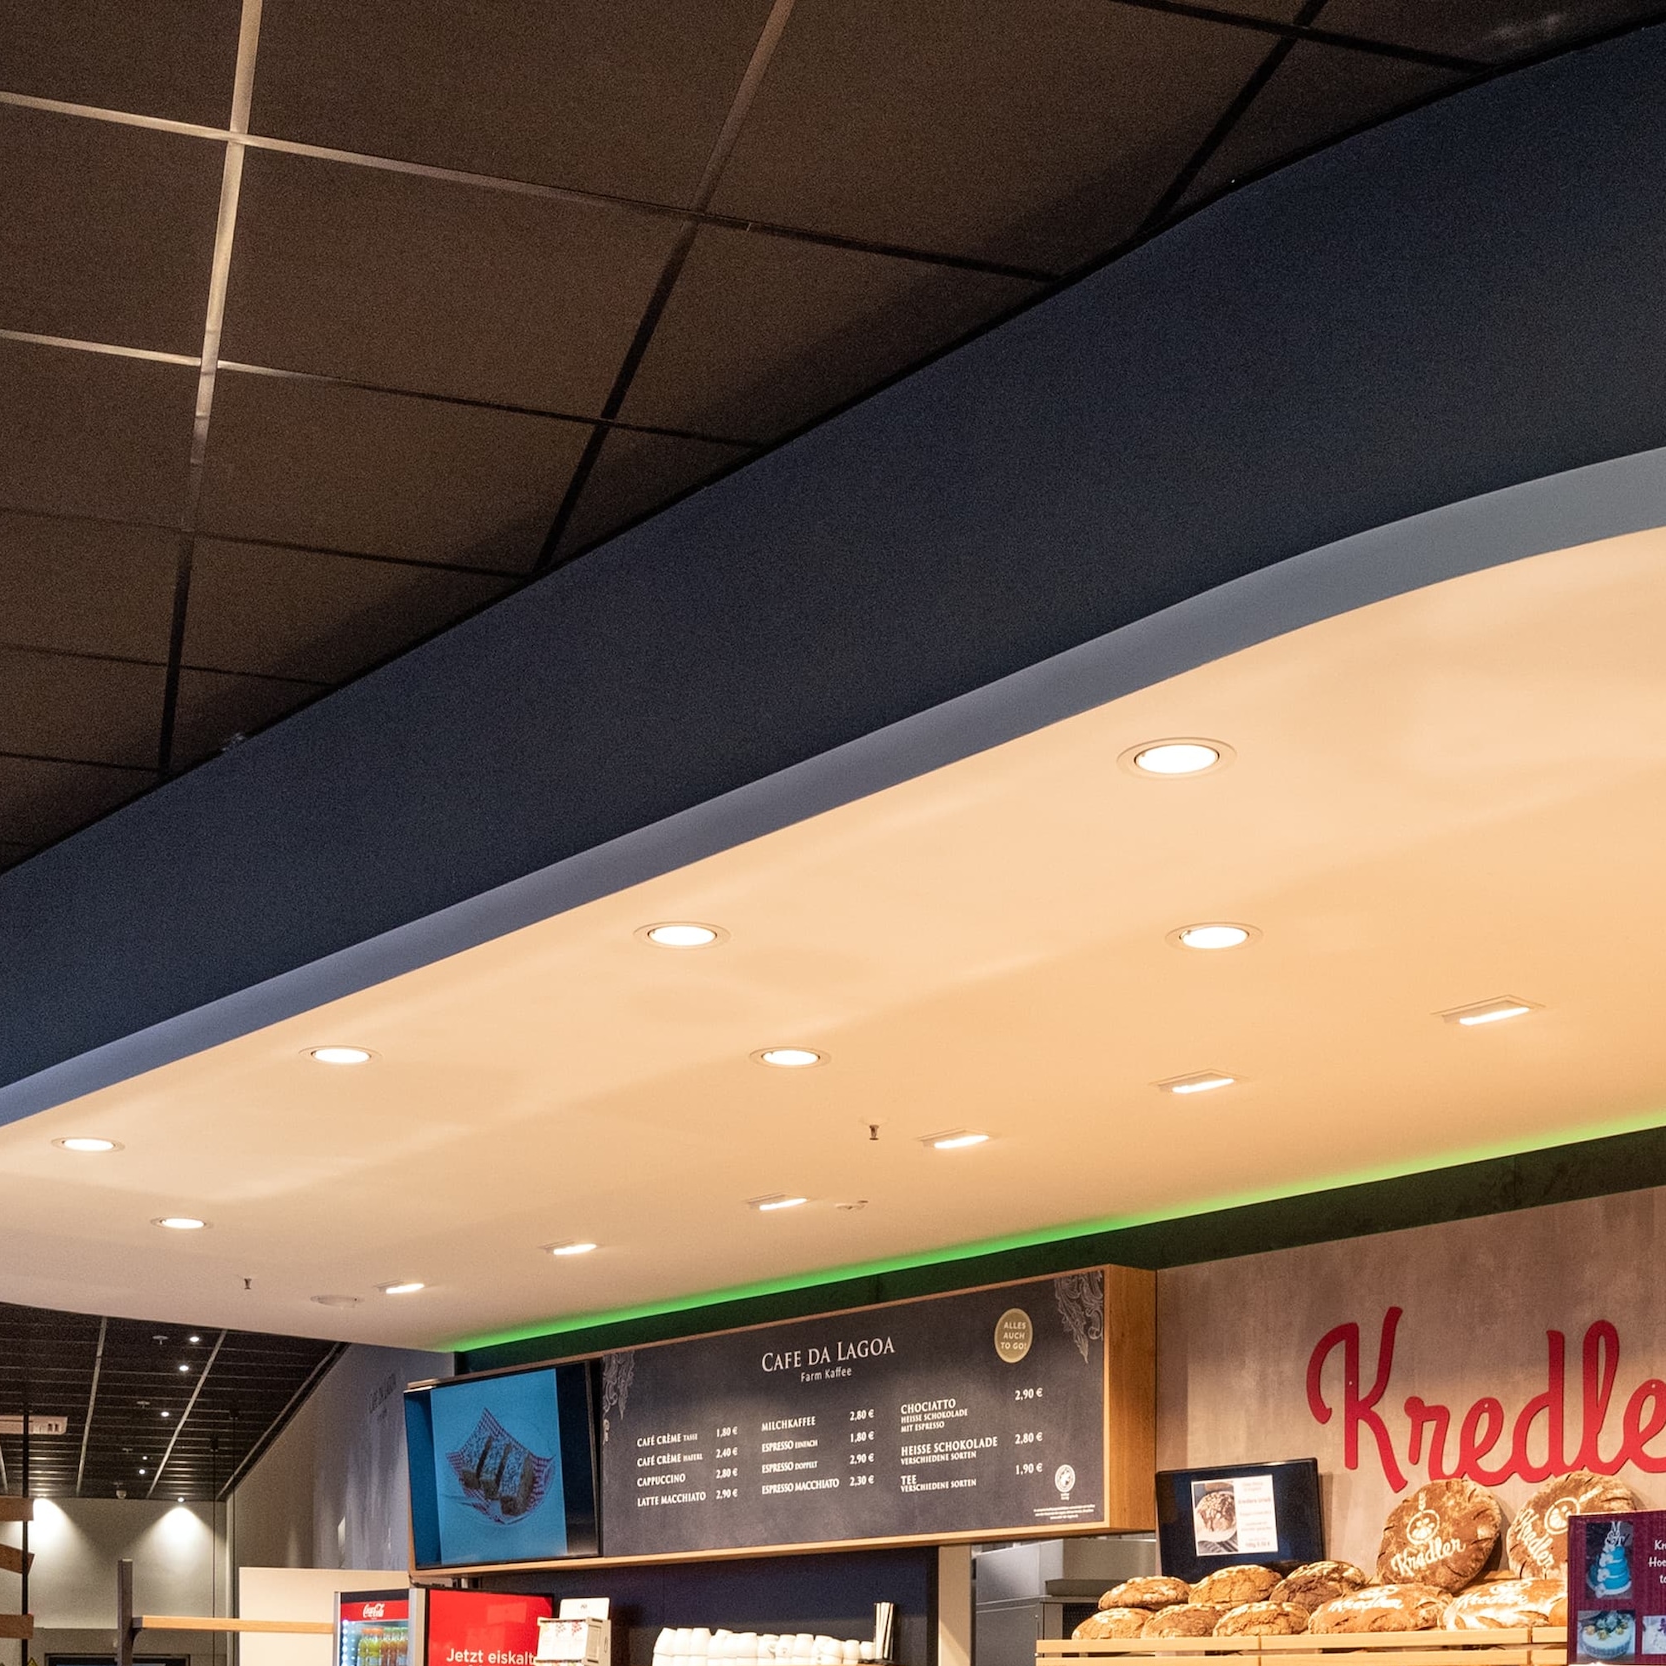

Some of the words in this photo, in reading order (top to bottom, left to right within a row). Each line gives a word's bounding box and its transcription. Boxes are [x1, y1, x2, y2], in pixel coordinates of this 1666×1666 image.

[1004, 1322, 1026, 1330] ALLES
[762, 1350, 801, 1372] CAFE
[808, 1347, 831, 1366] DA
[837, 1336, 895, 1361] LAGOA
[801, 1371, 822, 1382] Farm
[825, 1366, 852, 1380] Kaffee
[900, 1398, 956, 1415] CHOCIATTO
[1015, 1388, 1034, 1401] 2,90
[1036, 1387, 1043, 1397] €
[761, 1416, 816, 1432] MILCHKAFFEE
[849, 1409, 867, 1421] 2,80
[868, 1409, 874, 1418] €
[901, 1414, 922, 1424] HEISSE
[924, 1408, 968, 1422] SCHOKOLADE
[637, 1434, 655, 1447] CAFÉ
[656, 1432, 681, 1445] CRÈME
[716, 1427, 731, 1438] 1,80
[732, 1426, 738, 1435] €
[901, 1424, 913, 1433] MIT
[915, 1421, 945, 1432] ESPRESSO
[761, 1440, 794, 1453] ESPRESSO
[850, 1431, 867, 1443] 1,80
[868, 1431, 874, 1440] €
[901, 1443, 931, 1457] HEISSE
[934, 1436, 998, 1453] SCHOKOLADE
[1015, 1432, 1034, 1444] 2,80
[1036, 1432, 1043, 1442] €
[637, 1455, 655, 1468] CAFÉ
[656, 1453, 681, 1466] CRÈME
[716, 1448, 731, 1459] 2,40
[732, 1447, 738, 1456] €
[761, 1461, 794, 1474] ESPRESSO
[849, 1454, 867, 1465] 2,90
[868, 1453, 874, 1462] €
[900, 1453, 949, 1465] VERSCHIEDENE
[951, 1451, 977, 1461] SORTEN
[637, 1473, 686, 1487] CAPPUCCINO
[716, 1469, 731, 1480] 2,80
[732, 1468, 738, 1477] €
[900, 1474, 917, 1485] TEE
[1015, 1463, 1034, 1475] 1,90
[1036, 1462, 1043, 1472] €
[761, 1482, 794, 1495] ESPRESSO
[795, 1477, 840, 1492] MACCHIATO
[849, 1475, 867, 1487] 2,30
[868, 1475, 874, 1484] €
[900, 1480, 949, 1493] VERSCHIEDENE
[951, 1478, 977, 1488] SORTEN
[637, 1495, 659, 1507] LATTE
[661, 1491, 706, 1505] MACCHIATO
[716, 1489, 731, 1500] 2,90
[732, 1488, 738, 1498] €
[1390, 1535, 1467, 1577] Kredler
[446, 1648, 483, 1664] Jetzt
[487, 1650, 535, 1665] eiskalt
